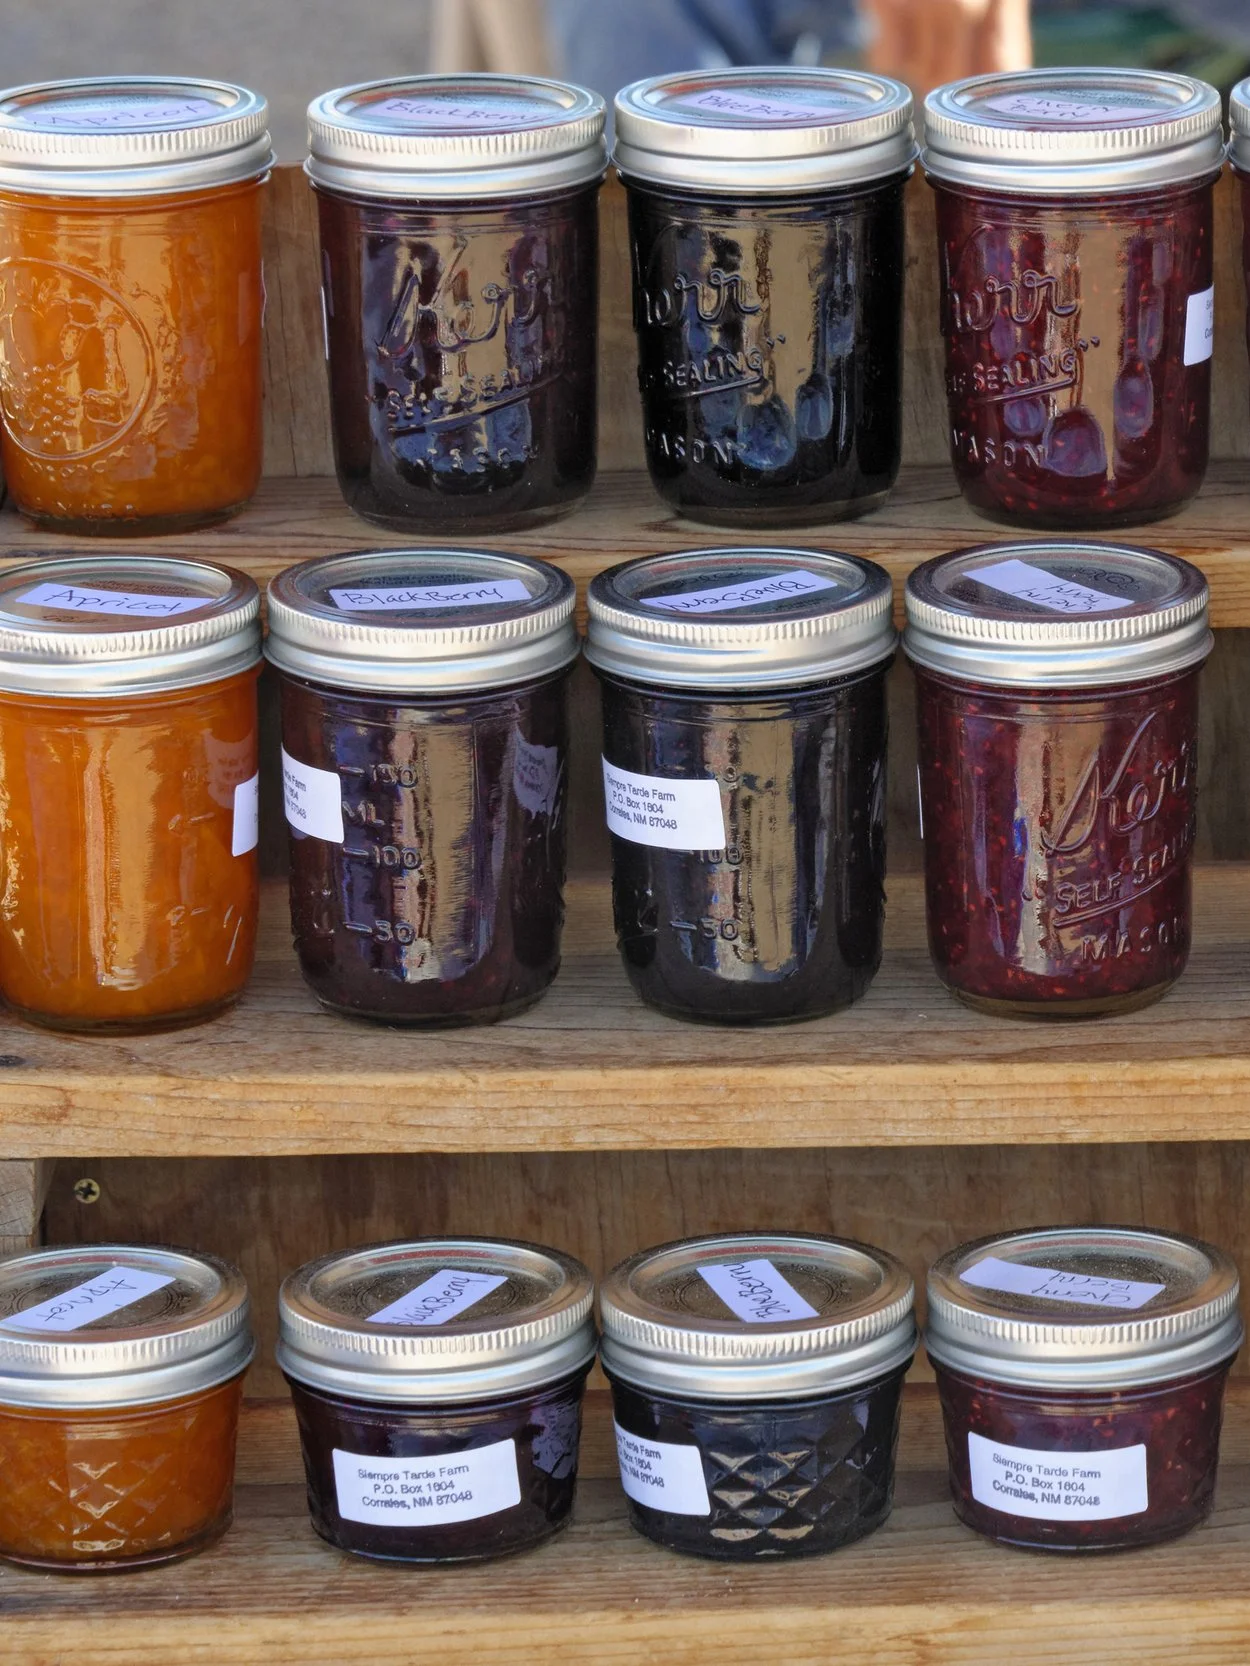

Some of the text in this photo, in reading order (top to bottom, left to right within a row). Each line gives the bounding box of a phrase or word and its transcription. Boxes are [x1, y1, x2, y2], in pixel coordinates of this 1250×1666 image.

[972, 349, 1079, 391] SEALING
[43, 589, 185, 613] Apricot
[627, 783, 650, 798] Tarde
[651, 788, 676, 802] Farm
[626, 796, 641, 811] Box
[633, 812, 648, 826] NM
[648, 816, 678, 830] 87048
[1049, 1271, 1132, 1292] Berry
[1031, 1283, 1132, 1305] Cherry
[639, 1444, 662, 1460] Farm
[357, 1463, 470, 1484] Siempre Tarde Farm
[992, 1452, 1102, 1479] Siempre Tarde Farm
[400, 1483, 423, 1495] Box
[1031, 1477, 1054, 1490] Box
[412, 1496, 434, 1509] NM
[435, 1490, 473, 1506] 87048
[1040, 1492, 1062, 1505] NM
[1064, 1494, 1101, 1507] 87048
